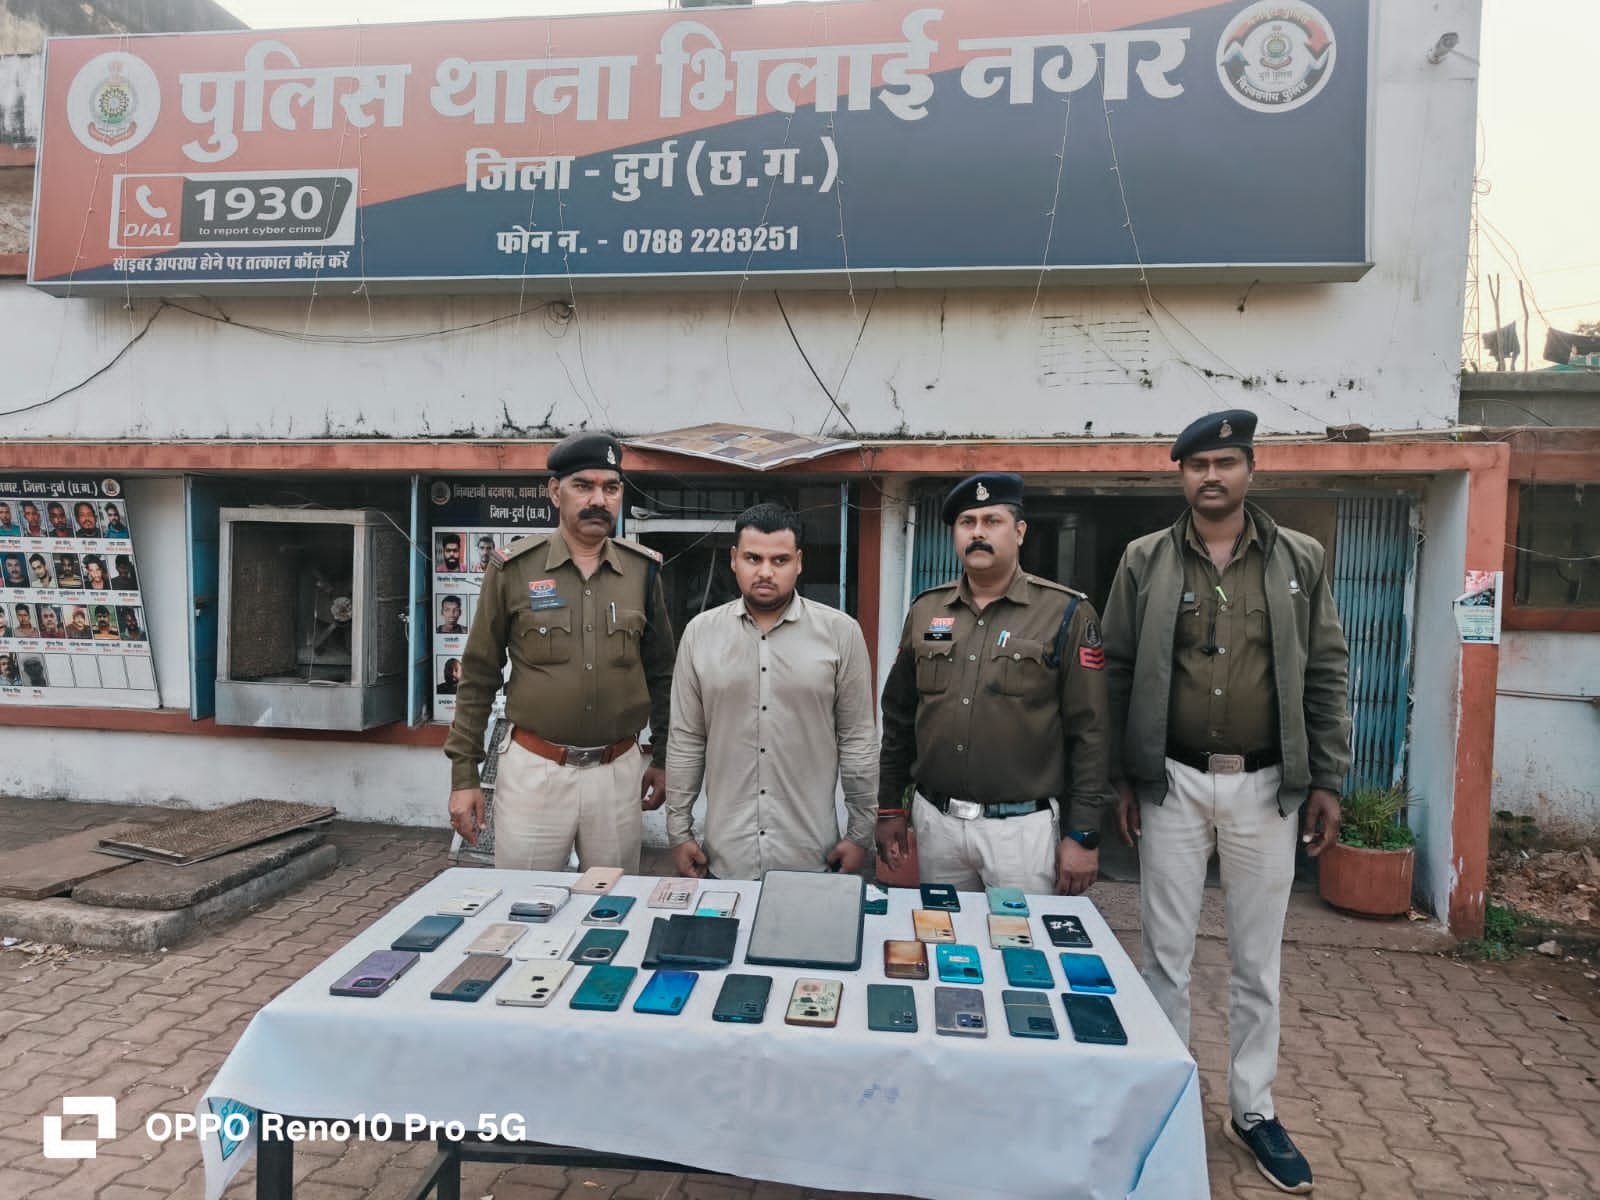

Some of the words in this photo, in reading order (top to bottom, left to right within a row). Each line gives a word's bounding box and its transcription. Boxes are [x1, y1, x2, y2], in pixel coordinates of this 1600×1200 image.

[179, 39, 412, 163] पुलिस
[430, 55, 638, 125] थाना
[656, 8, 944, 121] भिलाई
[958, 27, 1191, 105] नगर
[465, 147, 575, 192] जिला
[612, 139, 678, 201] दुर्ग
[686, 136, 839, 196] (छ.ग.)
[194, 185, 323, 222] 1930
[123, 223, 176, 237] DIAL
[199, 226, 210, 236] to
[213, 226, 249, 238] report
[252, 225, 287, 238] cyber
[288, 225, 322, 235] crime
[496, 224, 552, 254] फोन
[623, 227, 683, 254] 0788
[691, 225, 799, 254] 2283251
[154, 256, 198, 271] अपराध
[200, 252, 224, 271] होने
[226, 256, 244, 271] पर
[245, 255, 292, 271] तत्काल
[294, 251, 326, 270] कॉल
[328, 250, 350, 269] करें
